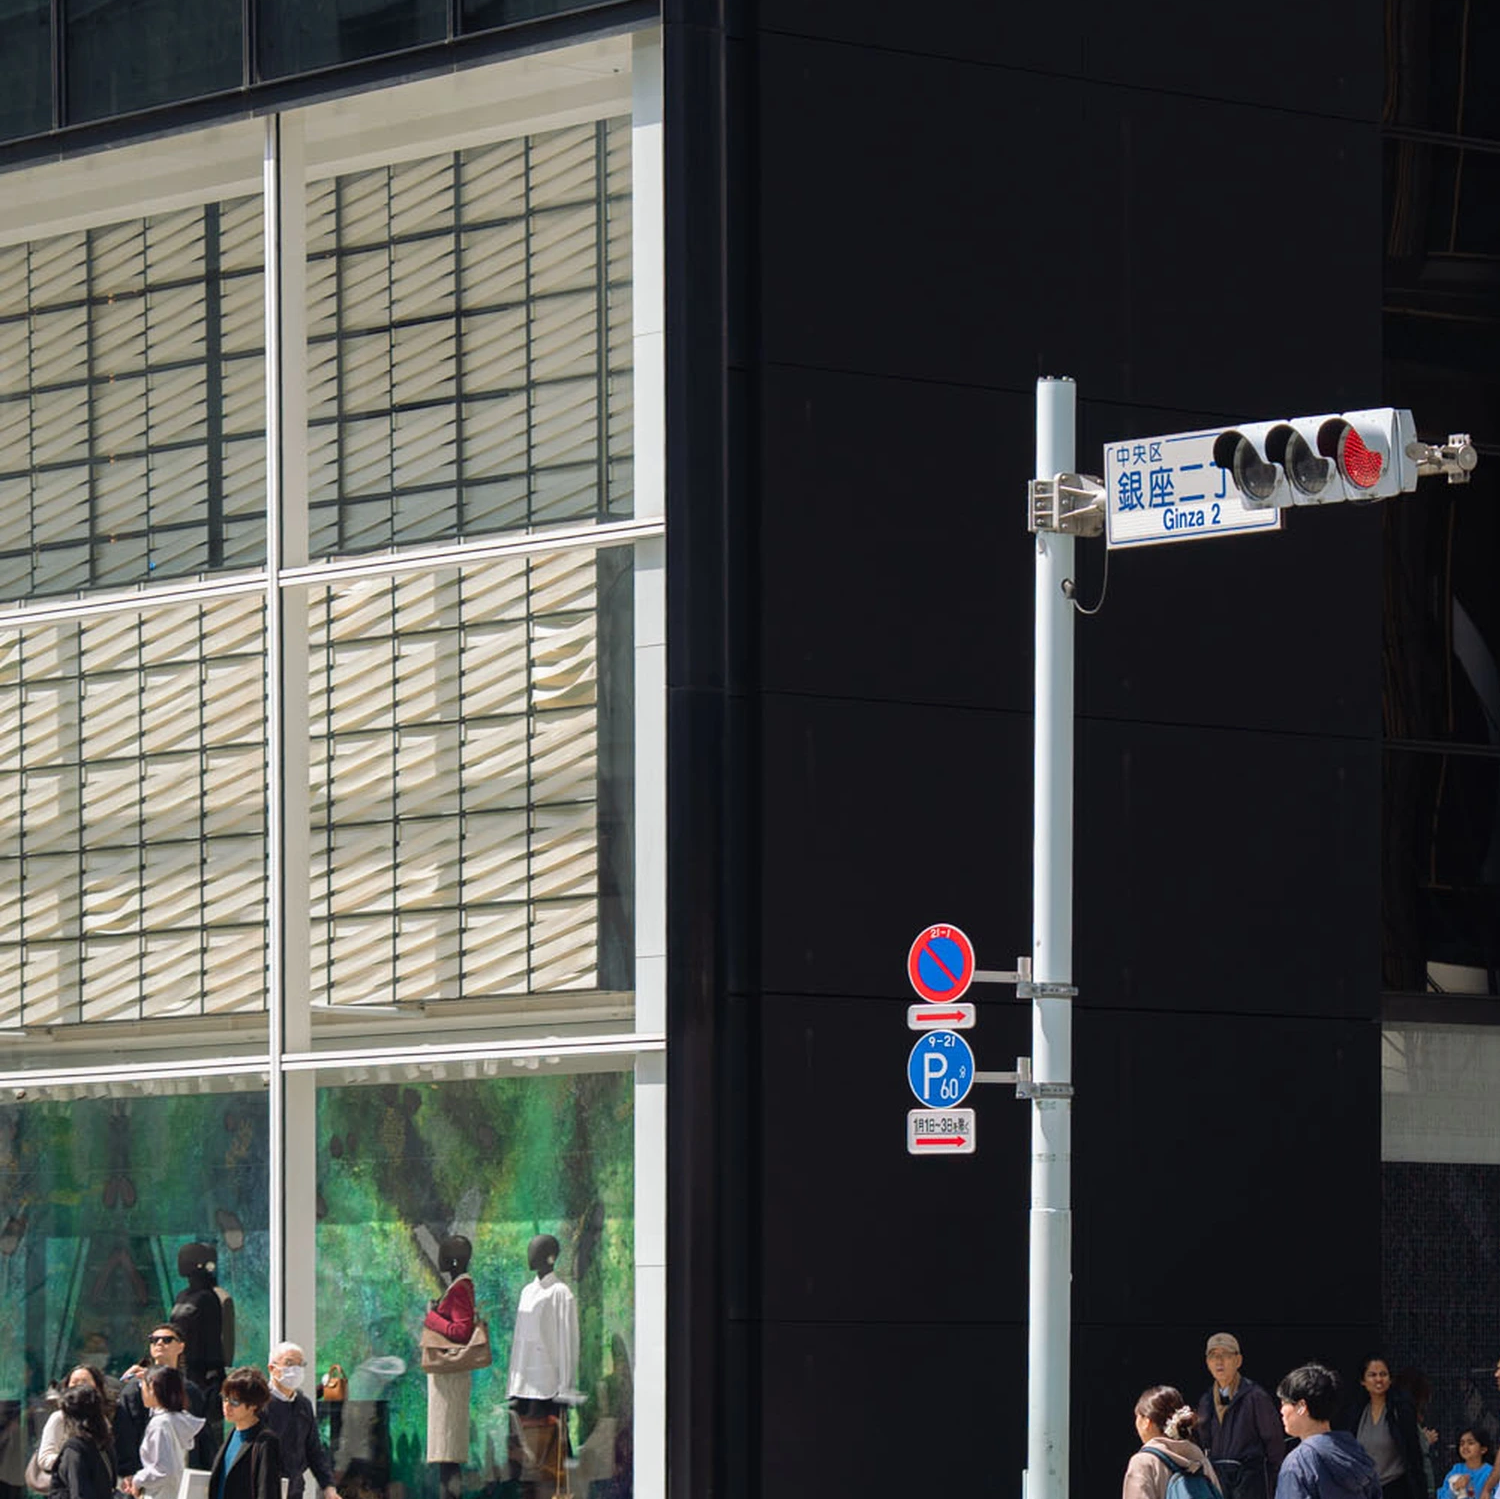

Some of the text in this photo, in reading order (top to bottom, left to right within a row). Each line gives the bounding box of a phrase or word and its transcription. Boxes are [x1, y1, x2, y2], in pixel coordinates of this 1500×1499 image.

[1116, 441, 1163, 467] 中央区
[1163, 503, 1221, 531] Ginza 2
[930, 928, 951, 939] 21-1
[928, 1035, 956, 1048] 9-21
[924, 1052, 948, 1100] P
[941, 1078, 959, 1099] 60
